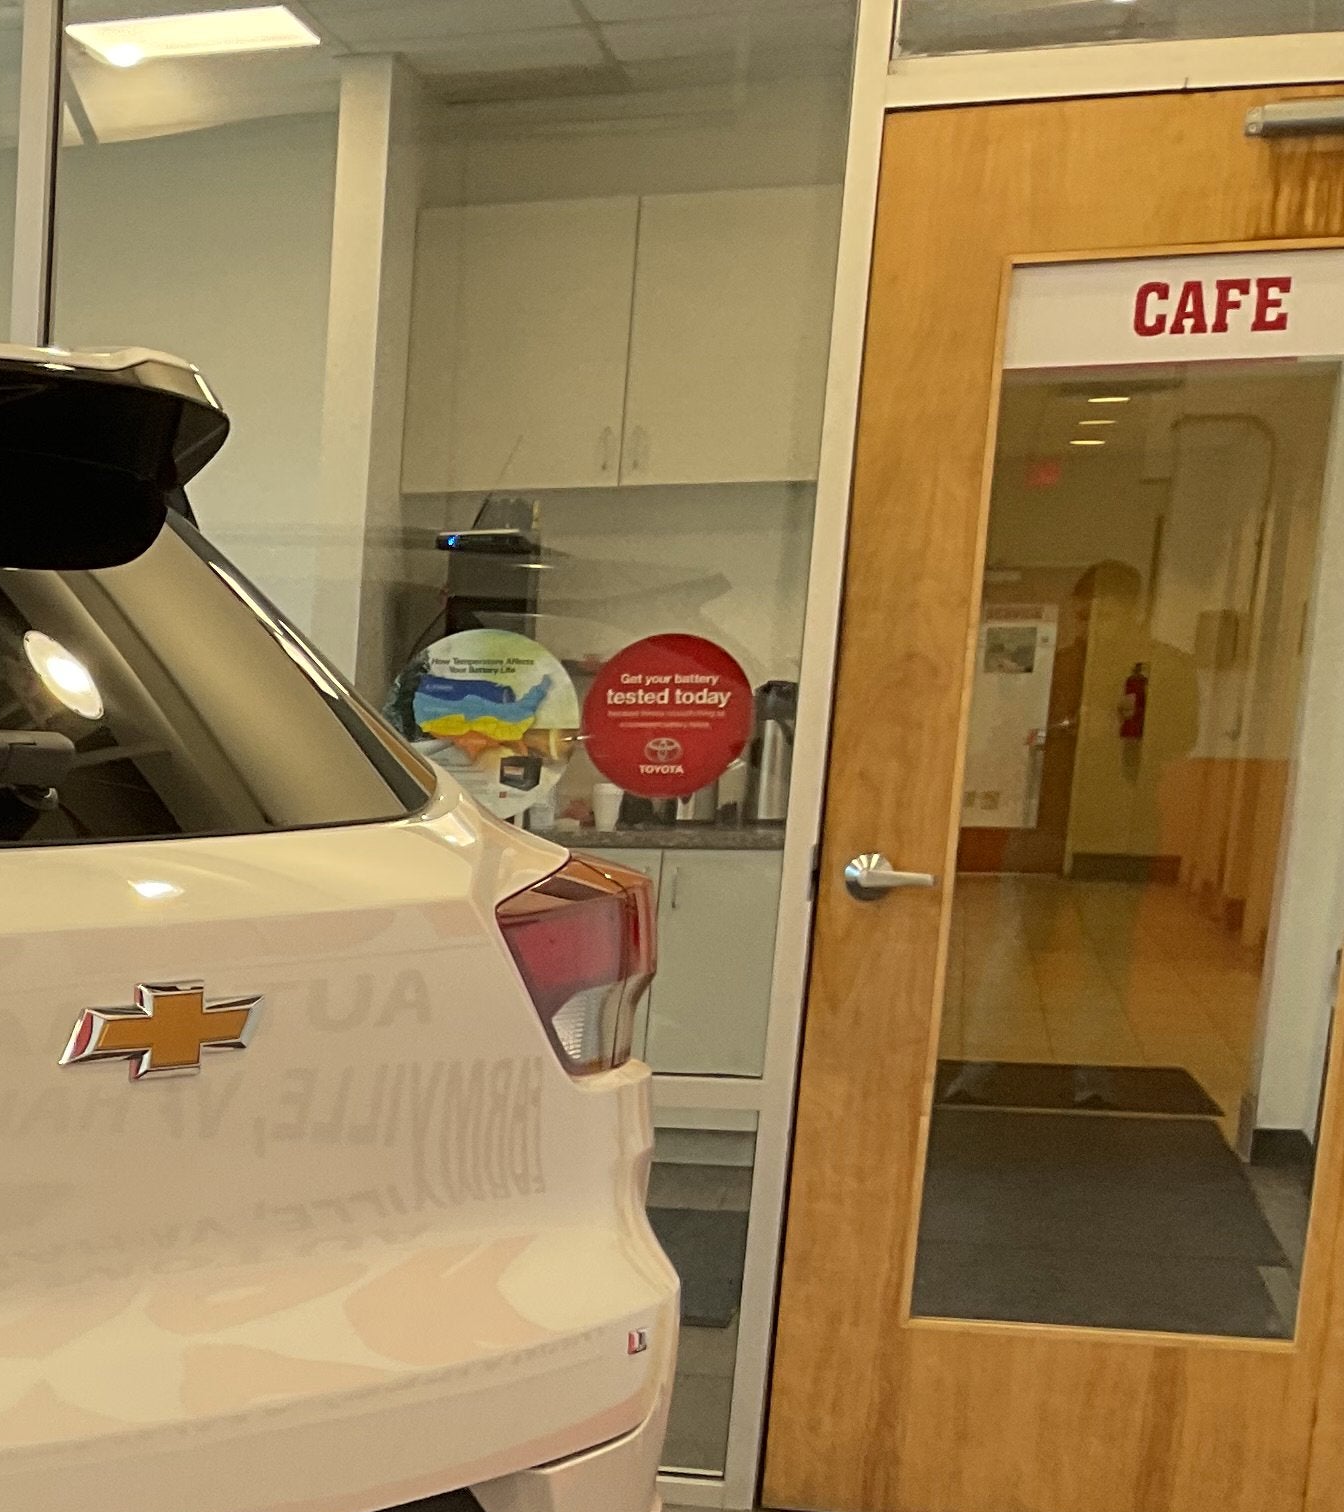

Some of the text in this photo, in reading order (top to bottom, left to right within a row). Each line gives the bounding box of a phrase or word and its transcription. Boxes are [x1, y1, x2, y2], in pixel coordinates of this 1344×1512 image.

[1133, 276, 1292, 337] CAFE
[620, 673, 720, 686] Get your battery
[606, 688, 732, 708] tested today
[639, 764, 685, 774] TOYOTA
